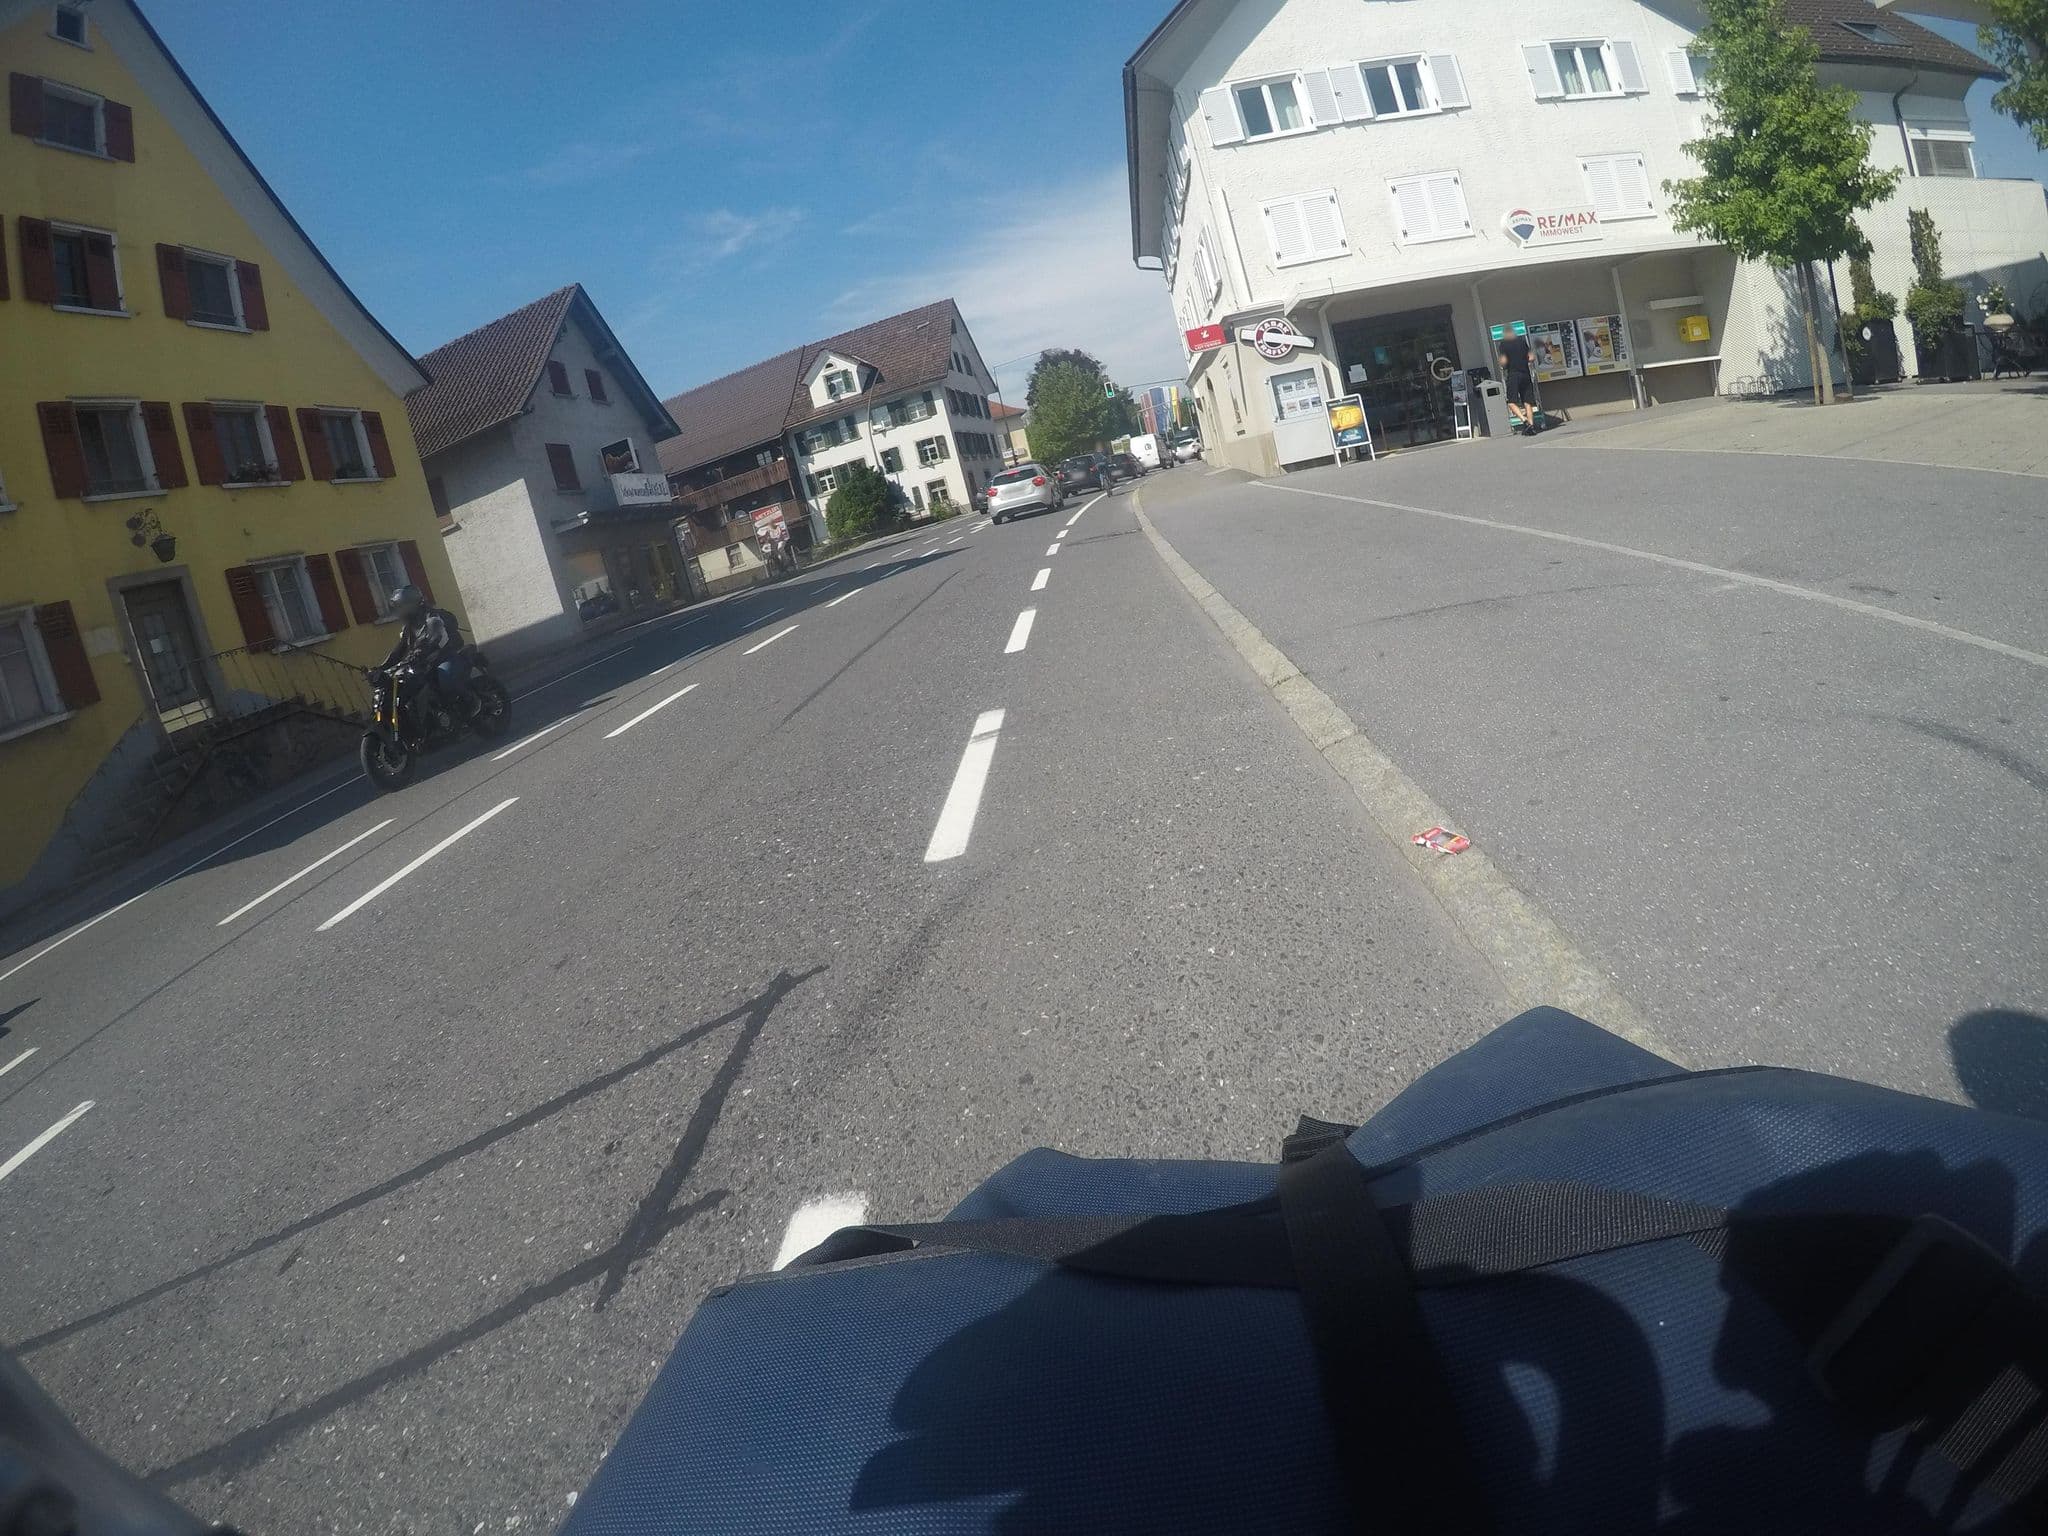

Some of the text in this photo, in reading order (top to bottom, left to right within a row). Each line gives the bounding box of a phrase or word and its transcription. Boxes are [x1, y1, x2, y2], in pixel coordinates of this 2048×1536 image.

[1512, 216, 1531, 224] RE/MAX
[1537, 211, 1598, 229] RE/MAX
[1539, 226, 1584, 237] IMMOWEST
[1259, 319, 1290, 333] TABAK
[1257, 339, 1290, 356] TRAFIK
